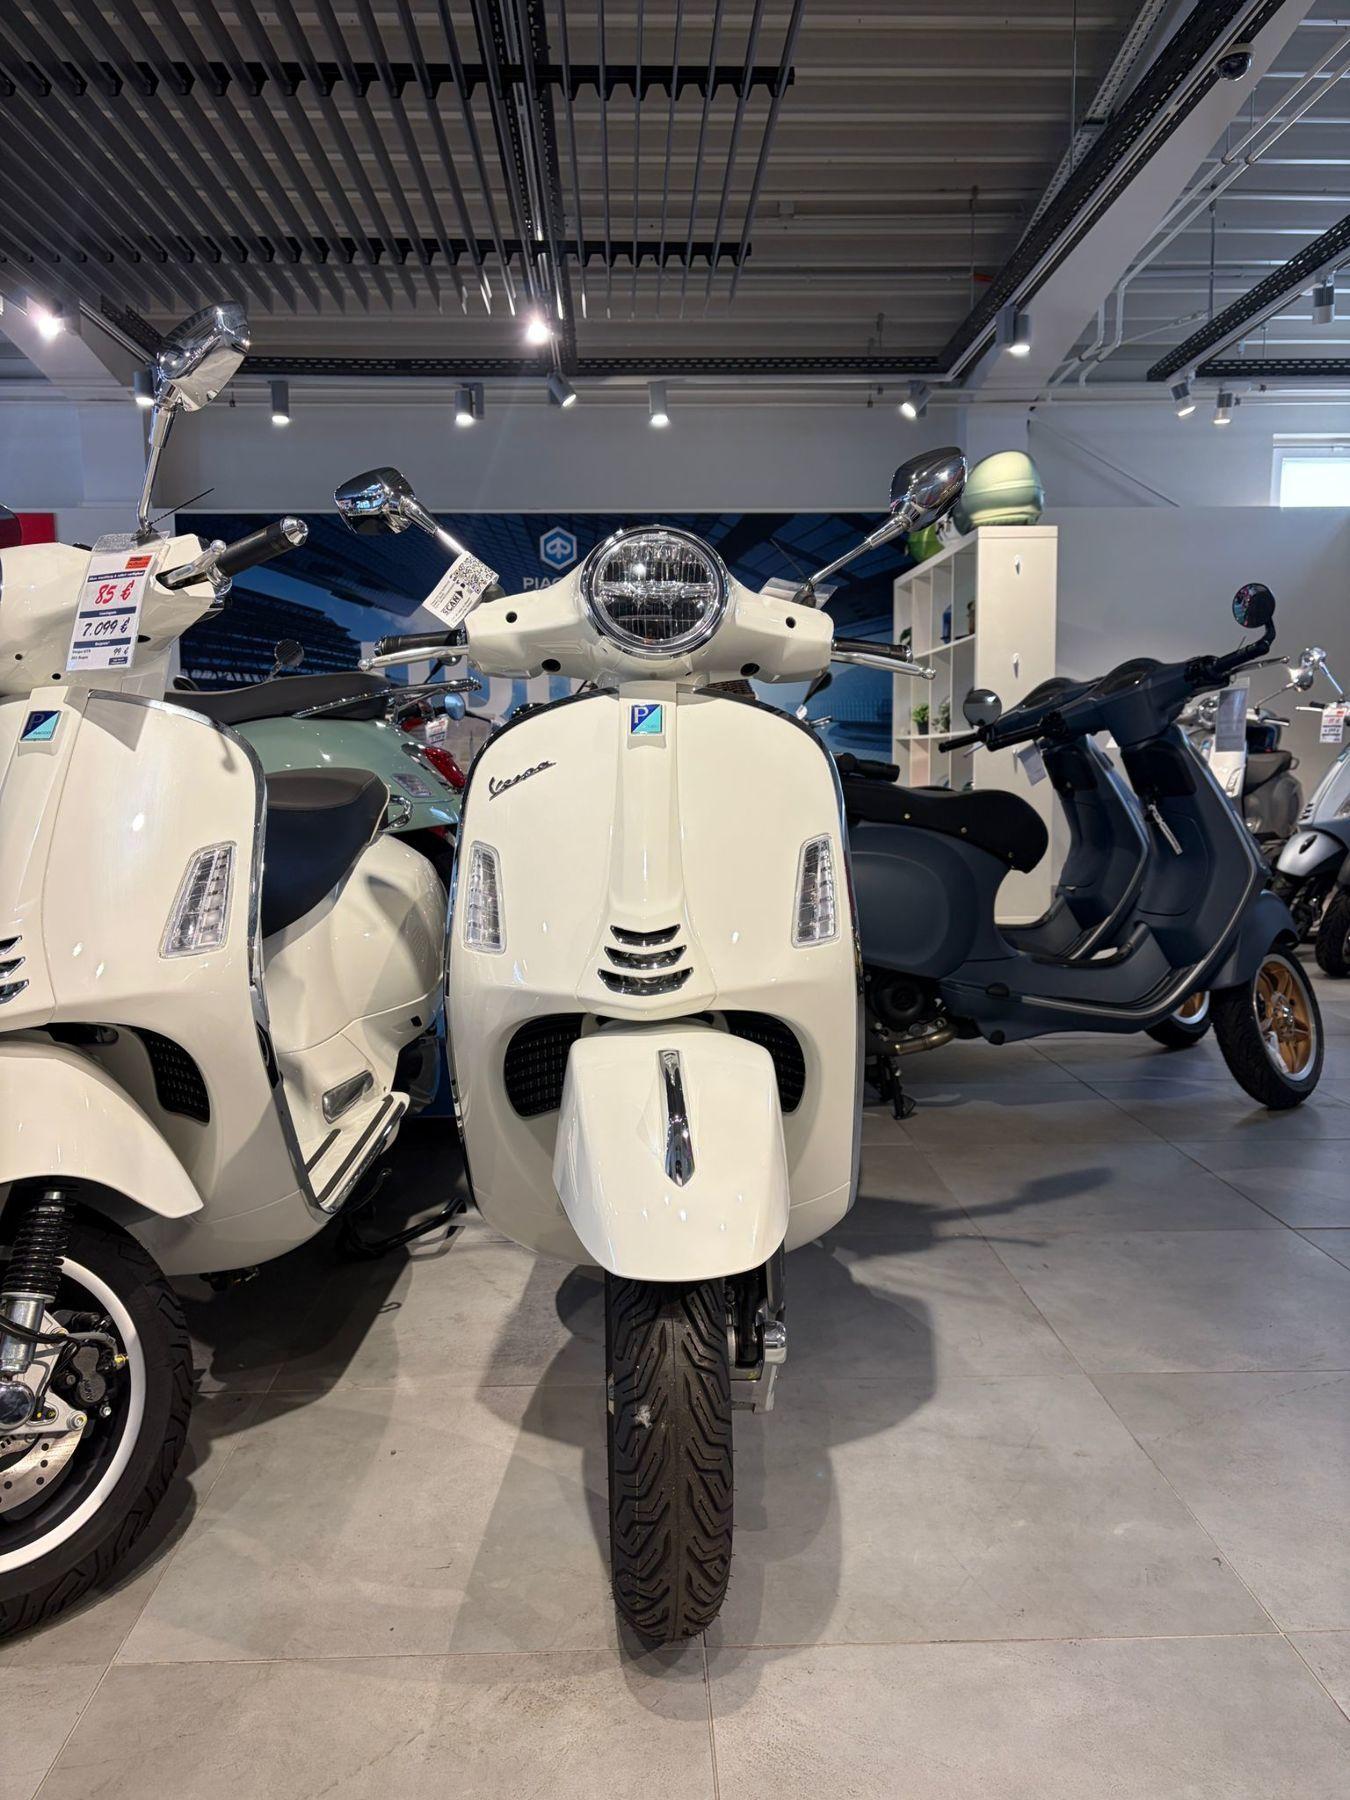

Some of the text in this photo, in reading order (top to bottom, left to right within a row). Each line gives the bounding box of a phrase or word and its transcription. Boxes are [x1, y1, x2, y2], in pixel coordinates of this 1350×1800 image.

[95, 580, 135, 605] 85 €
[440, 595, 460, 616] SCAN
[82, 617, 131, 637] 7.099 €
[27, 713, 45, 730] P
[634, 706, 649, 723] P
[488, 760, 557, 801] Vespa
